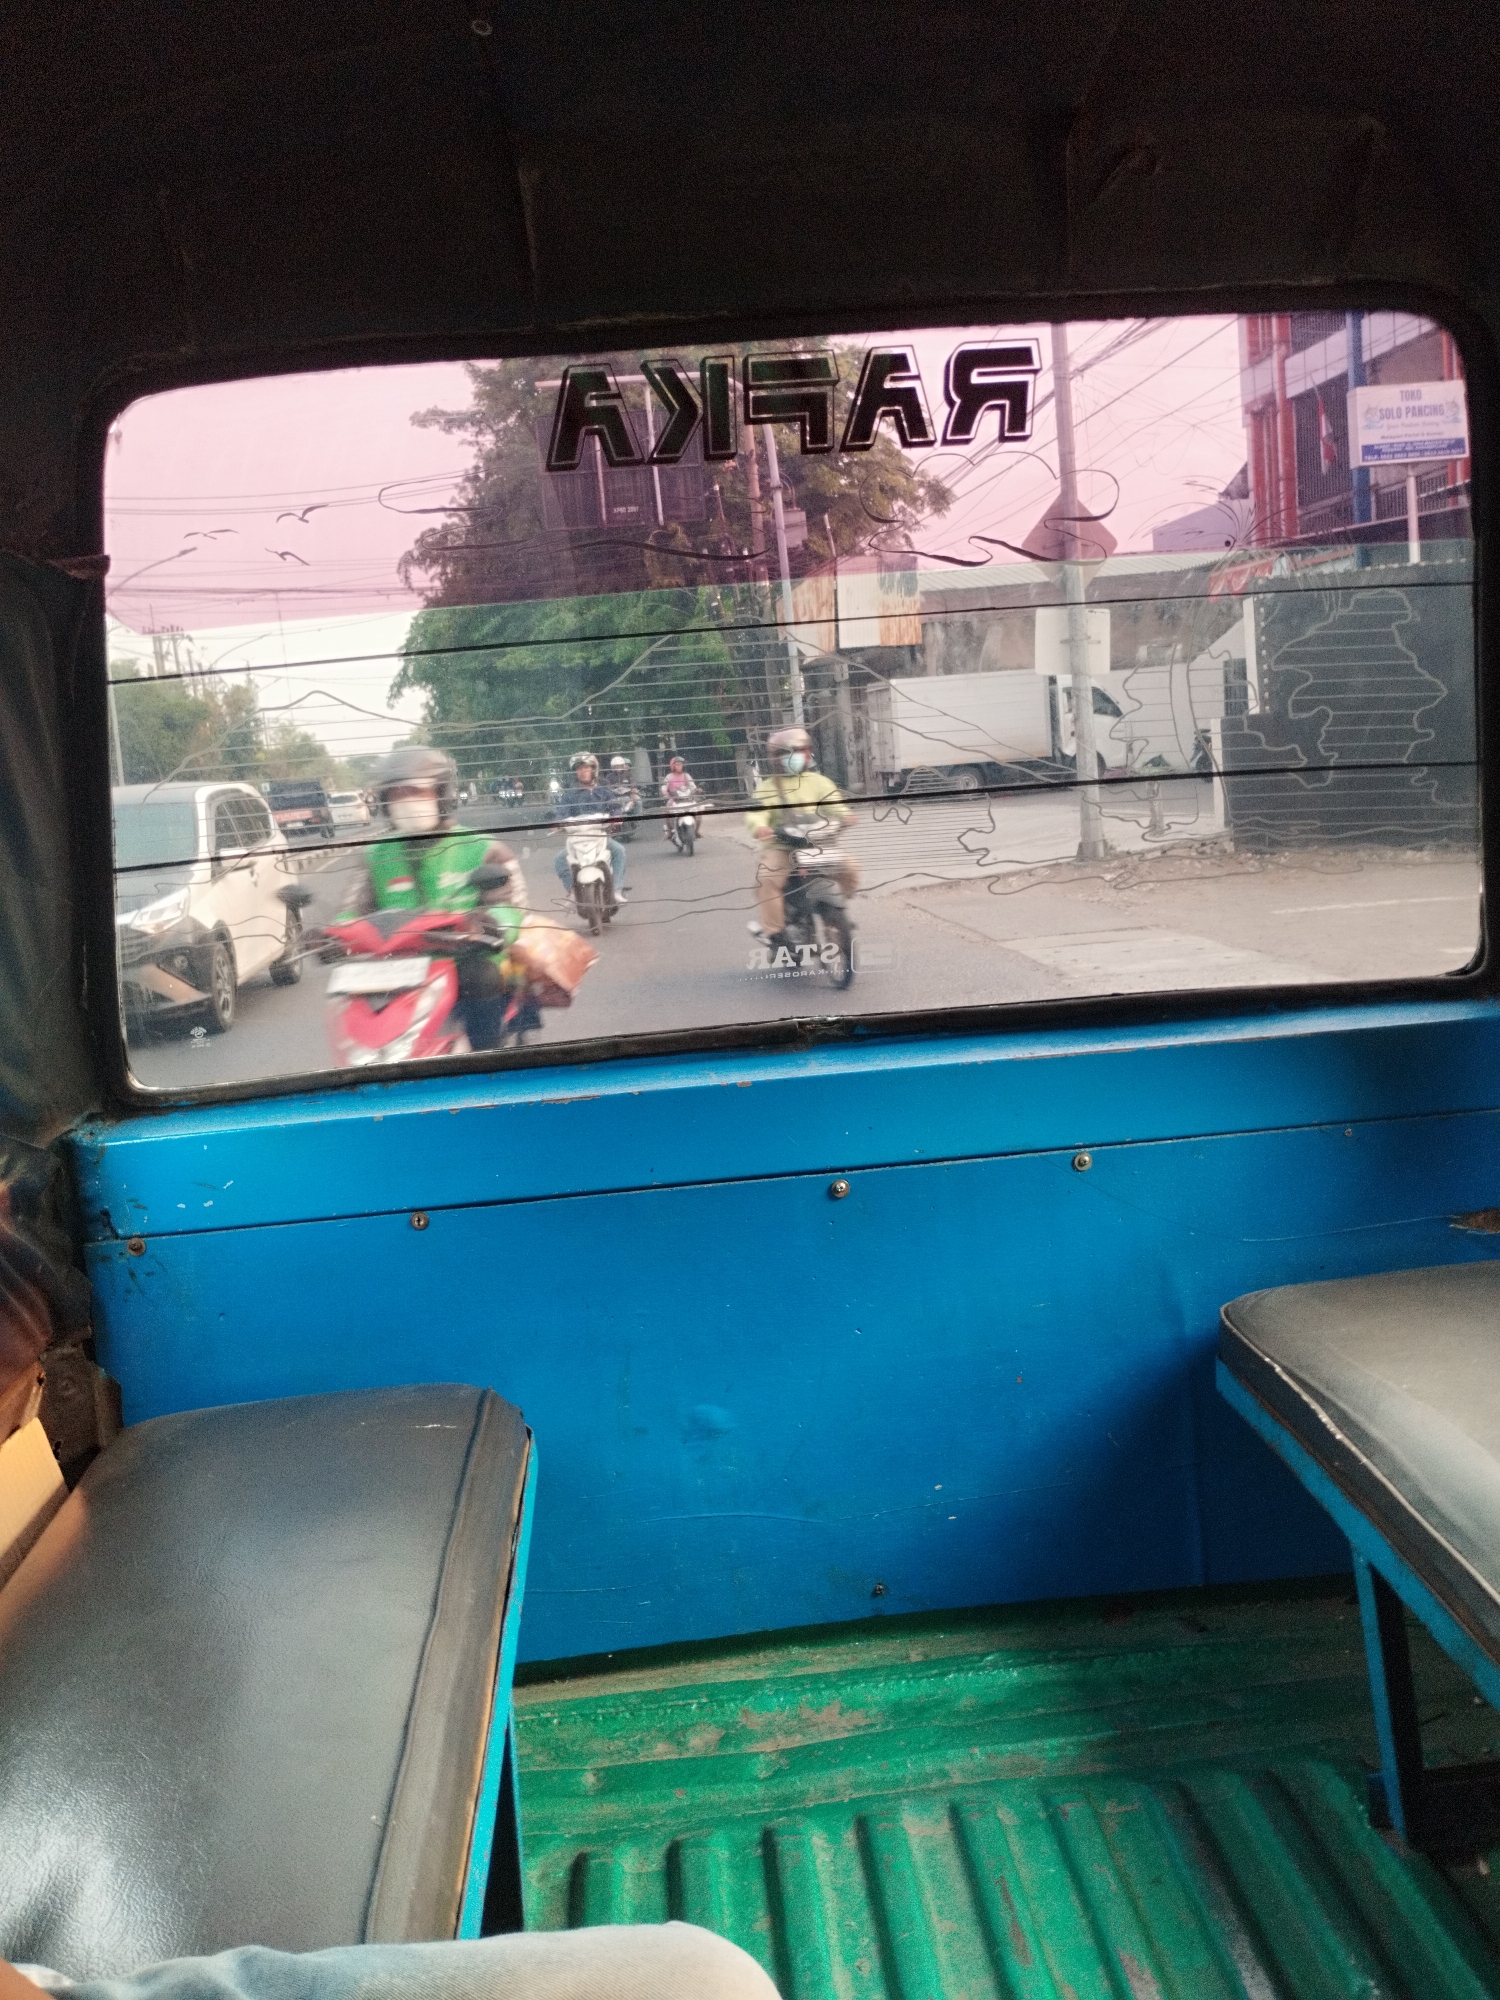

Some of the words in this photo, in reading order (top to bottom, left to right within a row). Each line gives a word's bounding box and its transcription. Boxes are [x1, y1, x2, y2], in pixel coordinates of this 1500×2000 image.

[1400, 389, 1422, 402] TOKO
[1379, 406, 1402, 420] SOLO
[1405, 403, 1445, 418] PANCING
